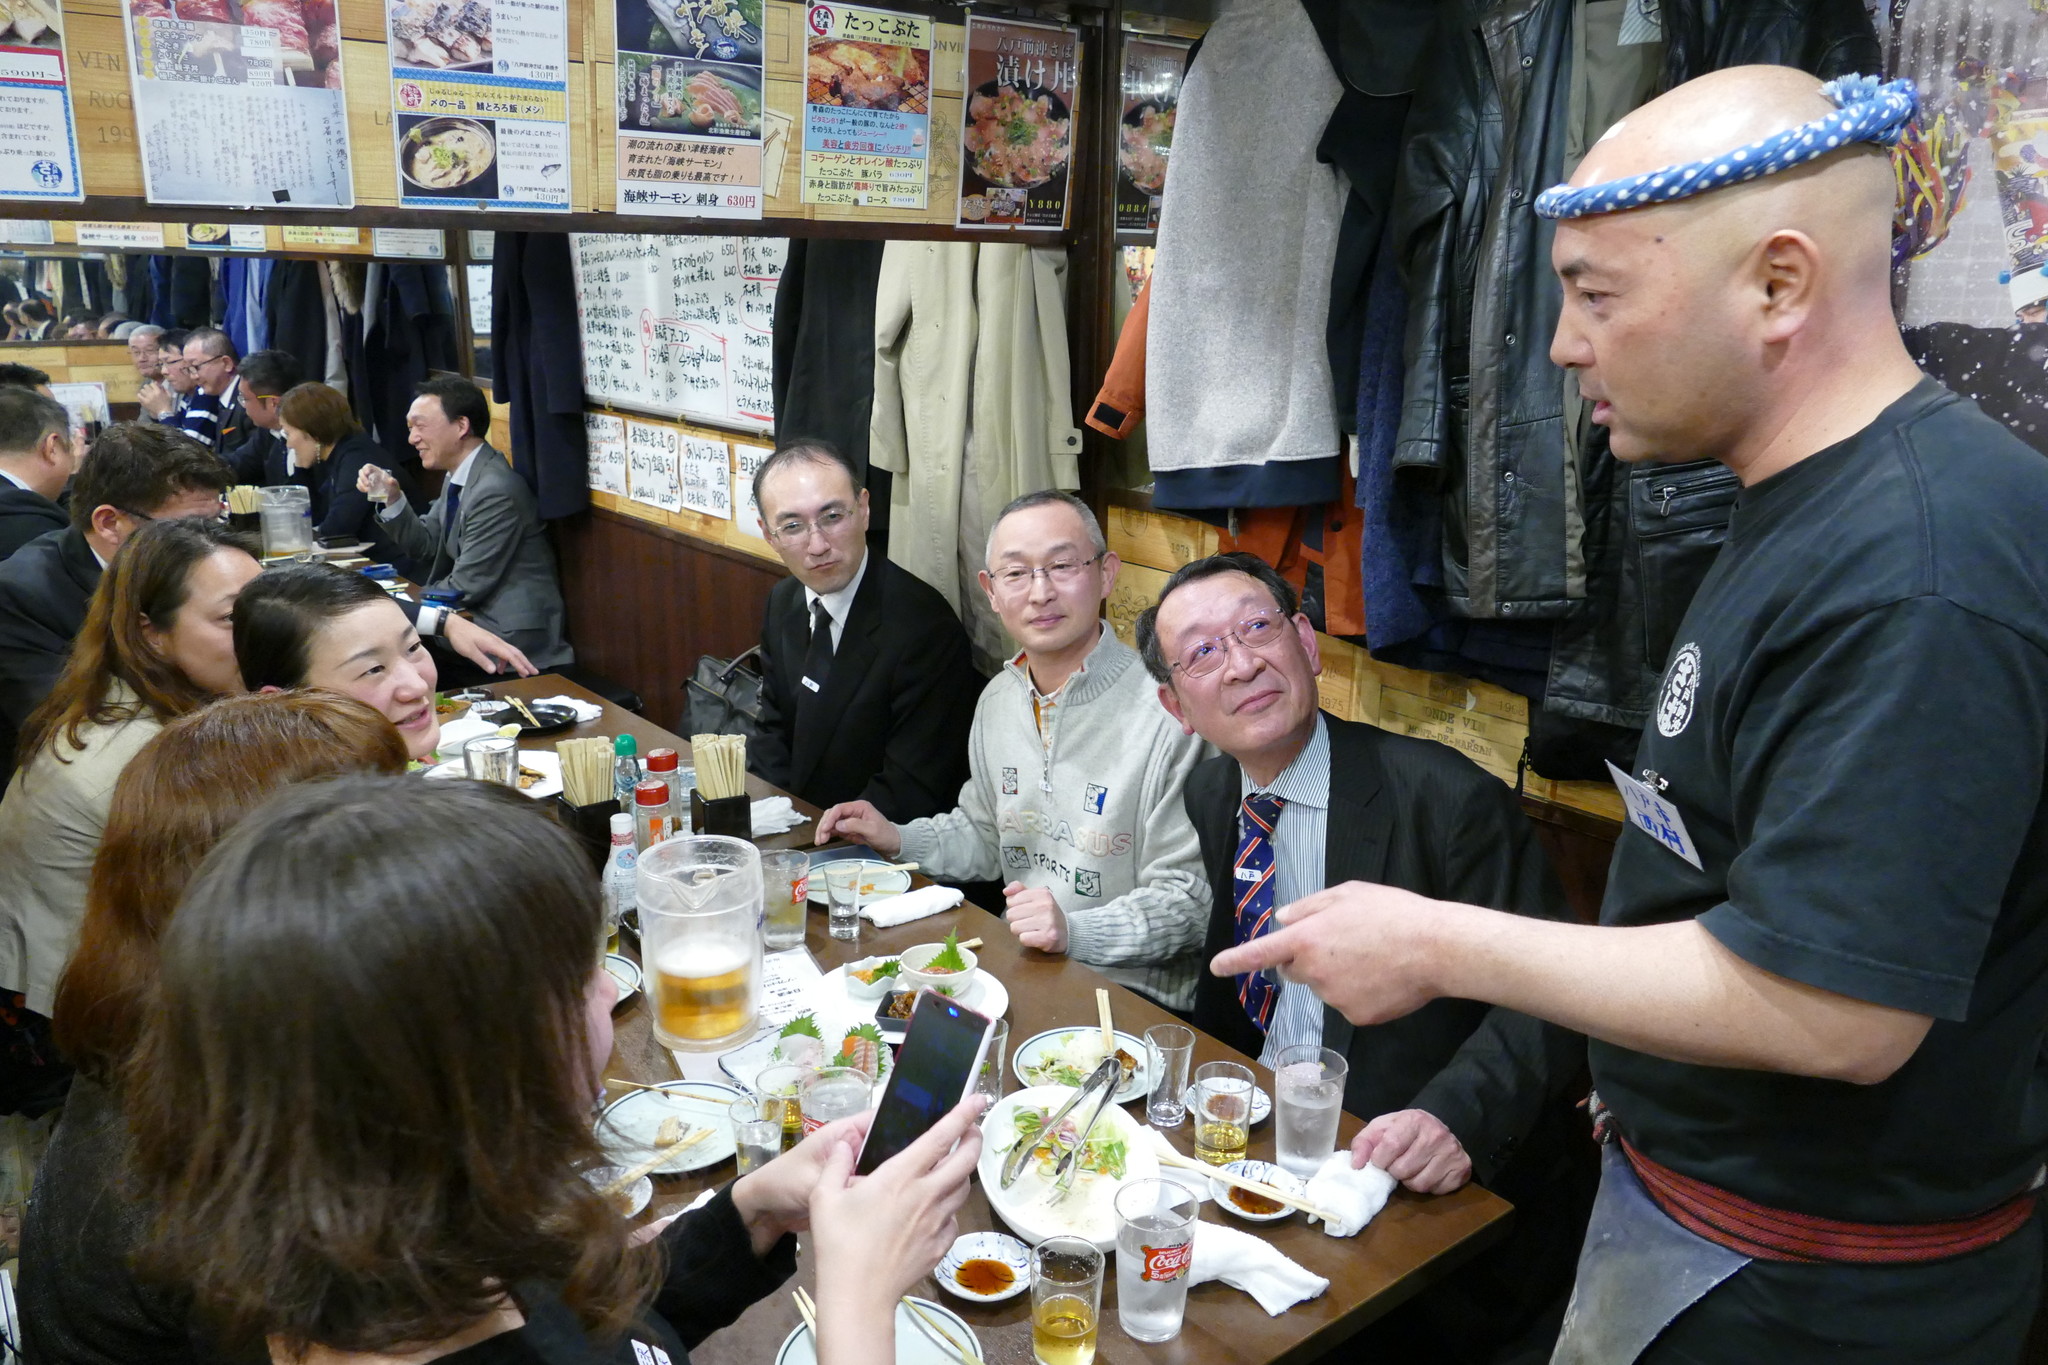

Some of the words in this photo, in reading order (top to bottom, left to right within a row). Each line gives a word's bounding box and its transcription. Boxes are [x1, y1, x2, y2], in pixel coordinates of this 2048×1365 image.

[844, 11, 921, 39] たっこぶた
[996, 36, 1075, 59] 八戸前沖さば
[430, 98, 467, 111] 〆の一品
[626, 138, 735, 156] 潮の流れの速い津軽海峡で
[811, 153, 922, 170] コラーゲンとオレイン酸たっぷり
[819, 166, 854, 178] たっこぶた
[861, 169, 883, 180] 豚バラ
[623, 188, 692, 205] 海峡サーモン
[696, 192, 719, 207] 刺身
[727, 194, 756, 208] 630円
[817, 192, 852, 203] たっこぶた
[866, 195, 888, 204] ロース
[1029, 199, 1061, 210] ¥880
[1033, 853, 1072, 883] SPORTS
